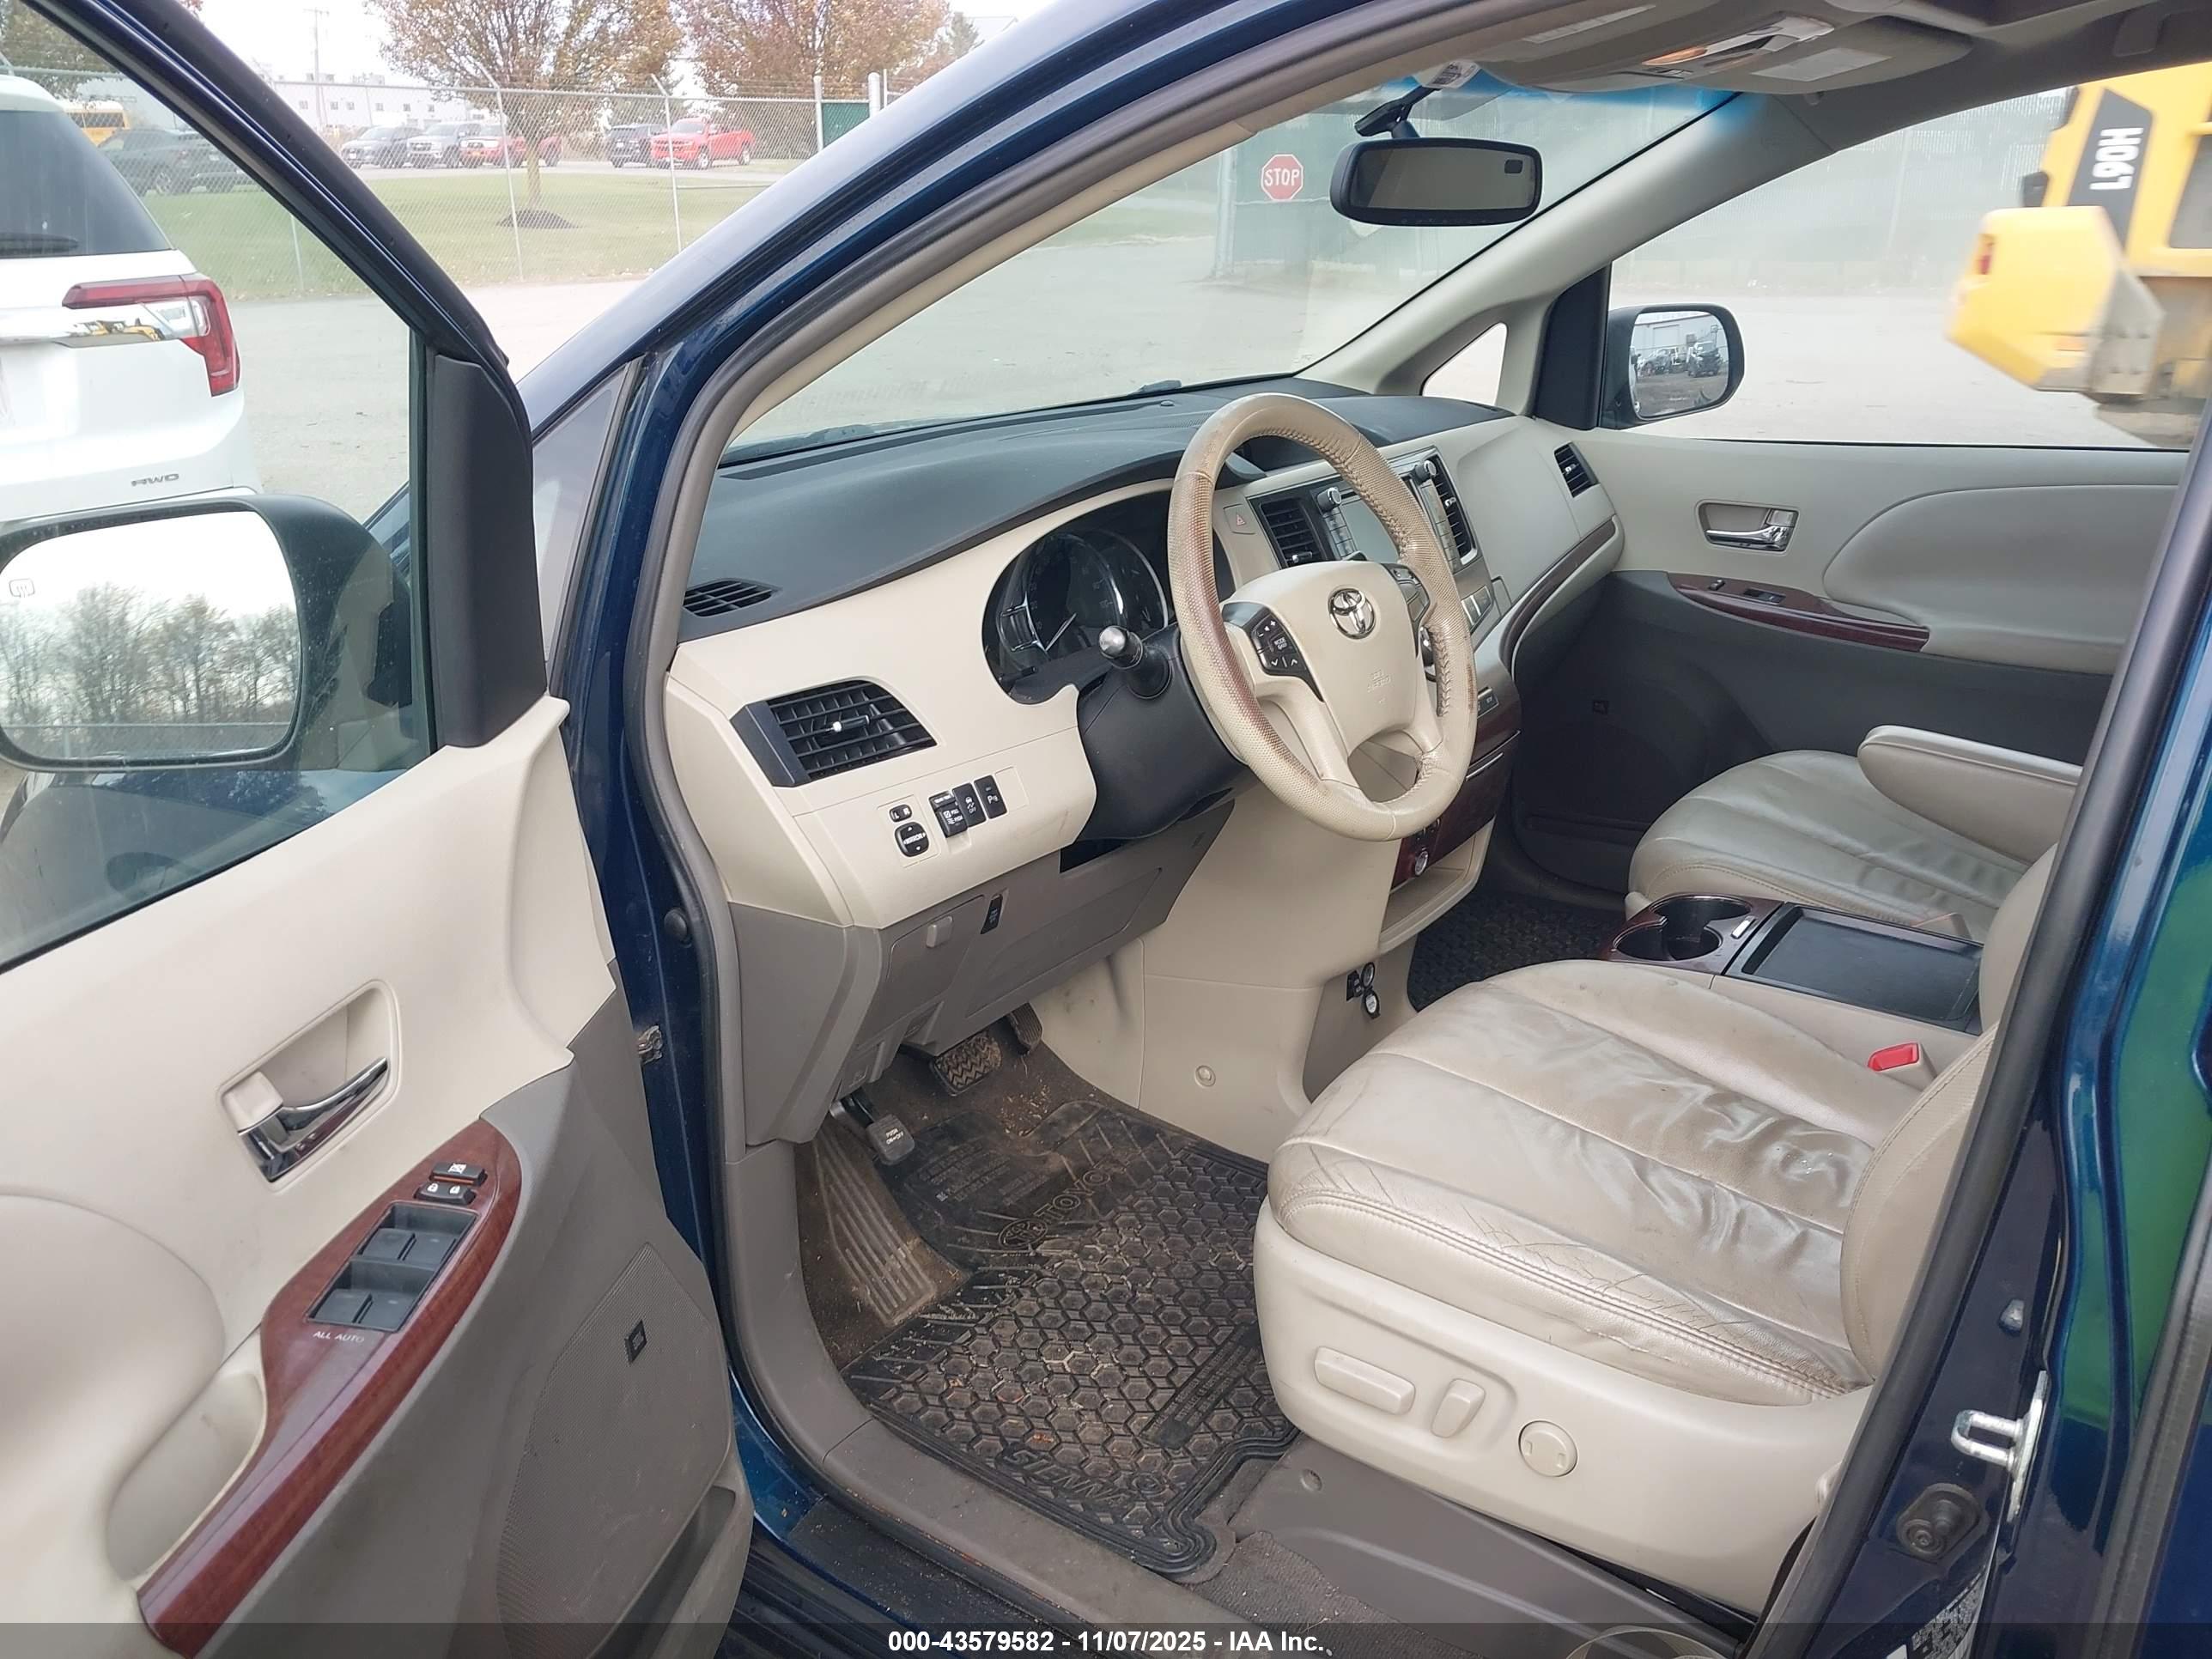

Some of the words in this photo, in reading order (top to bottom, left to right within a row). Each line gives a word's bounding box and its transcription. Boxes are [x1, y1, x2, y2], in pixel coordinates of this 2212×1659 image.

[2089, 128, 2144, 191] L90H
[1264, 167, 1300, 186] STOP
[903, 807, 910, 816] R
[313, 1331, 331, 1340] ALL
[334, 1334, 365, 1343] AUTO
